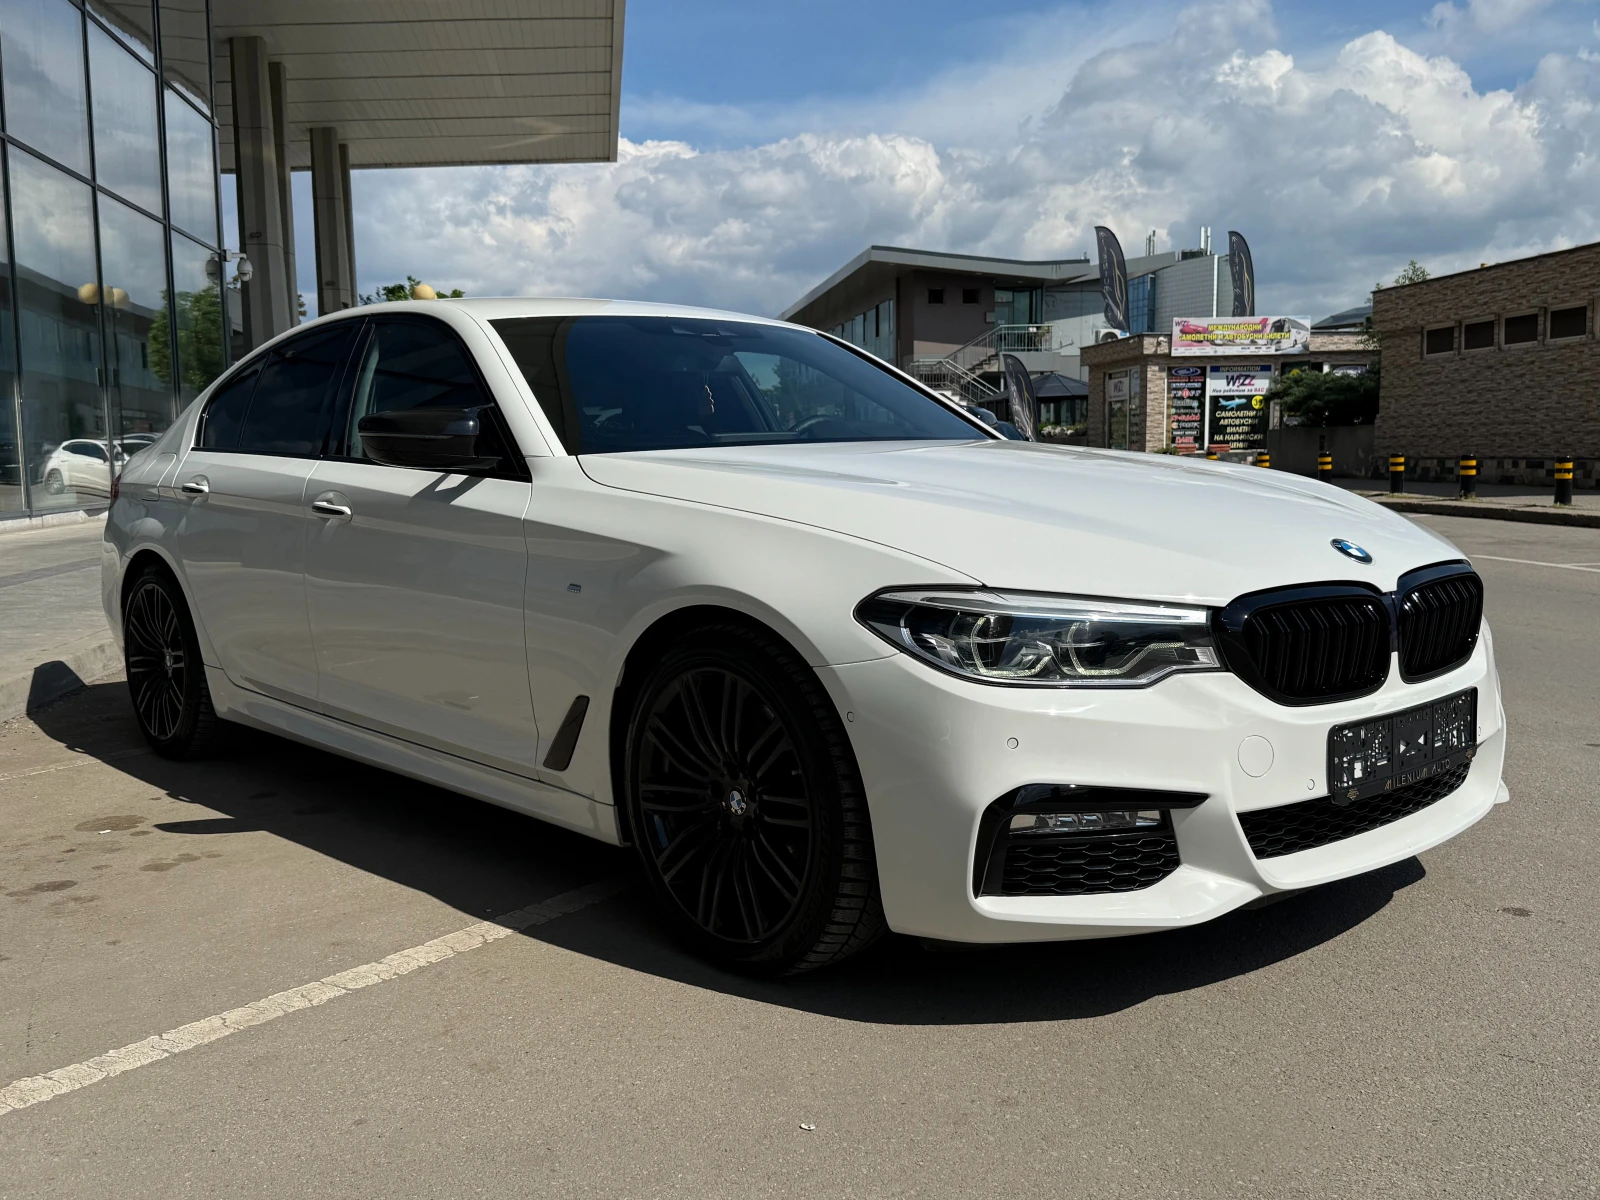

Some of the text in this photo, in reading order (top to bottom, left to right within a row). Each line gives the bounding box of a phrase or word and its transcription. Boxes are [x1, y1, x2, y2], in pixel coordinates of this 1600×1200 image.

[1208, 323, 1262, 332] МЕЖДУНАРОДНИ
[1178, 333, 1218, 341] САМОЛЕТНИ
[1225, 332, 1263, 340] АВТОБУСНИ
[1264, 331, 1291, 340] БИЛЕТИ
[1215, 410, 1256, 418] САМОЛЕТНИ
[1219, 418, 1259, 426] АВТОБУСНИ
[1384, 758, 1451, 790] MILENIUM AUTO
